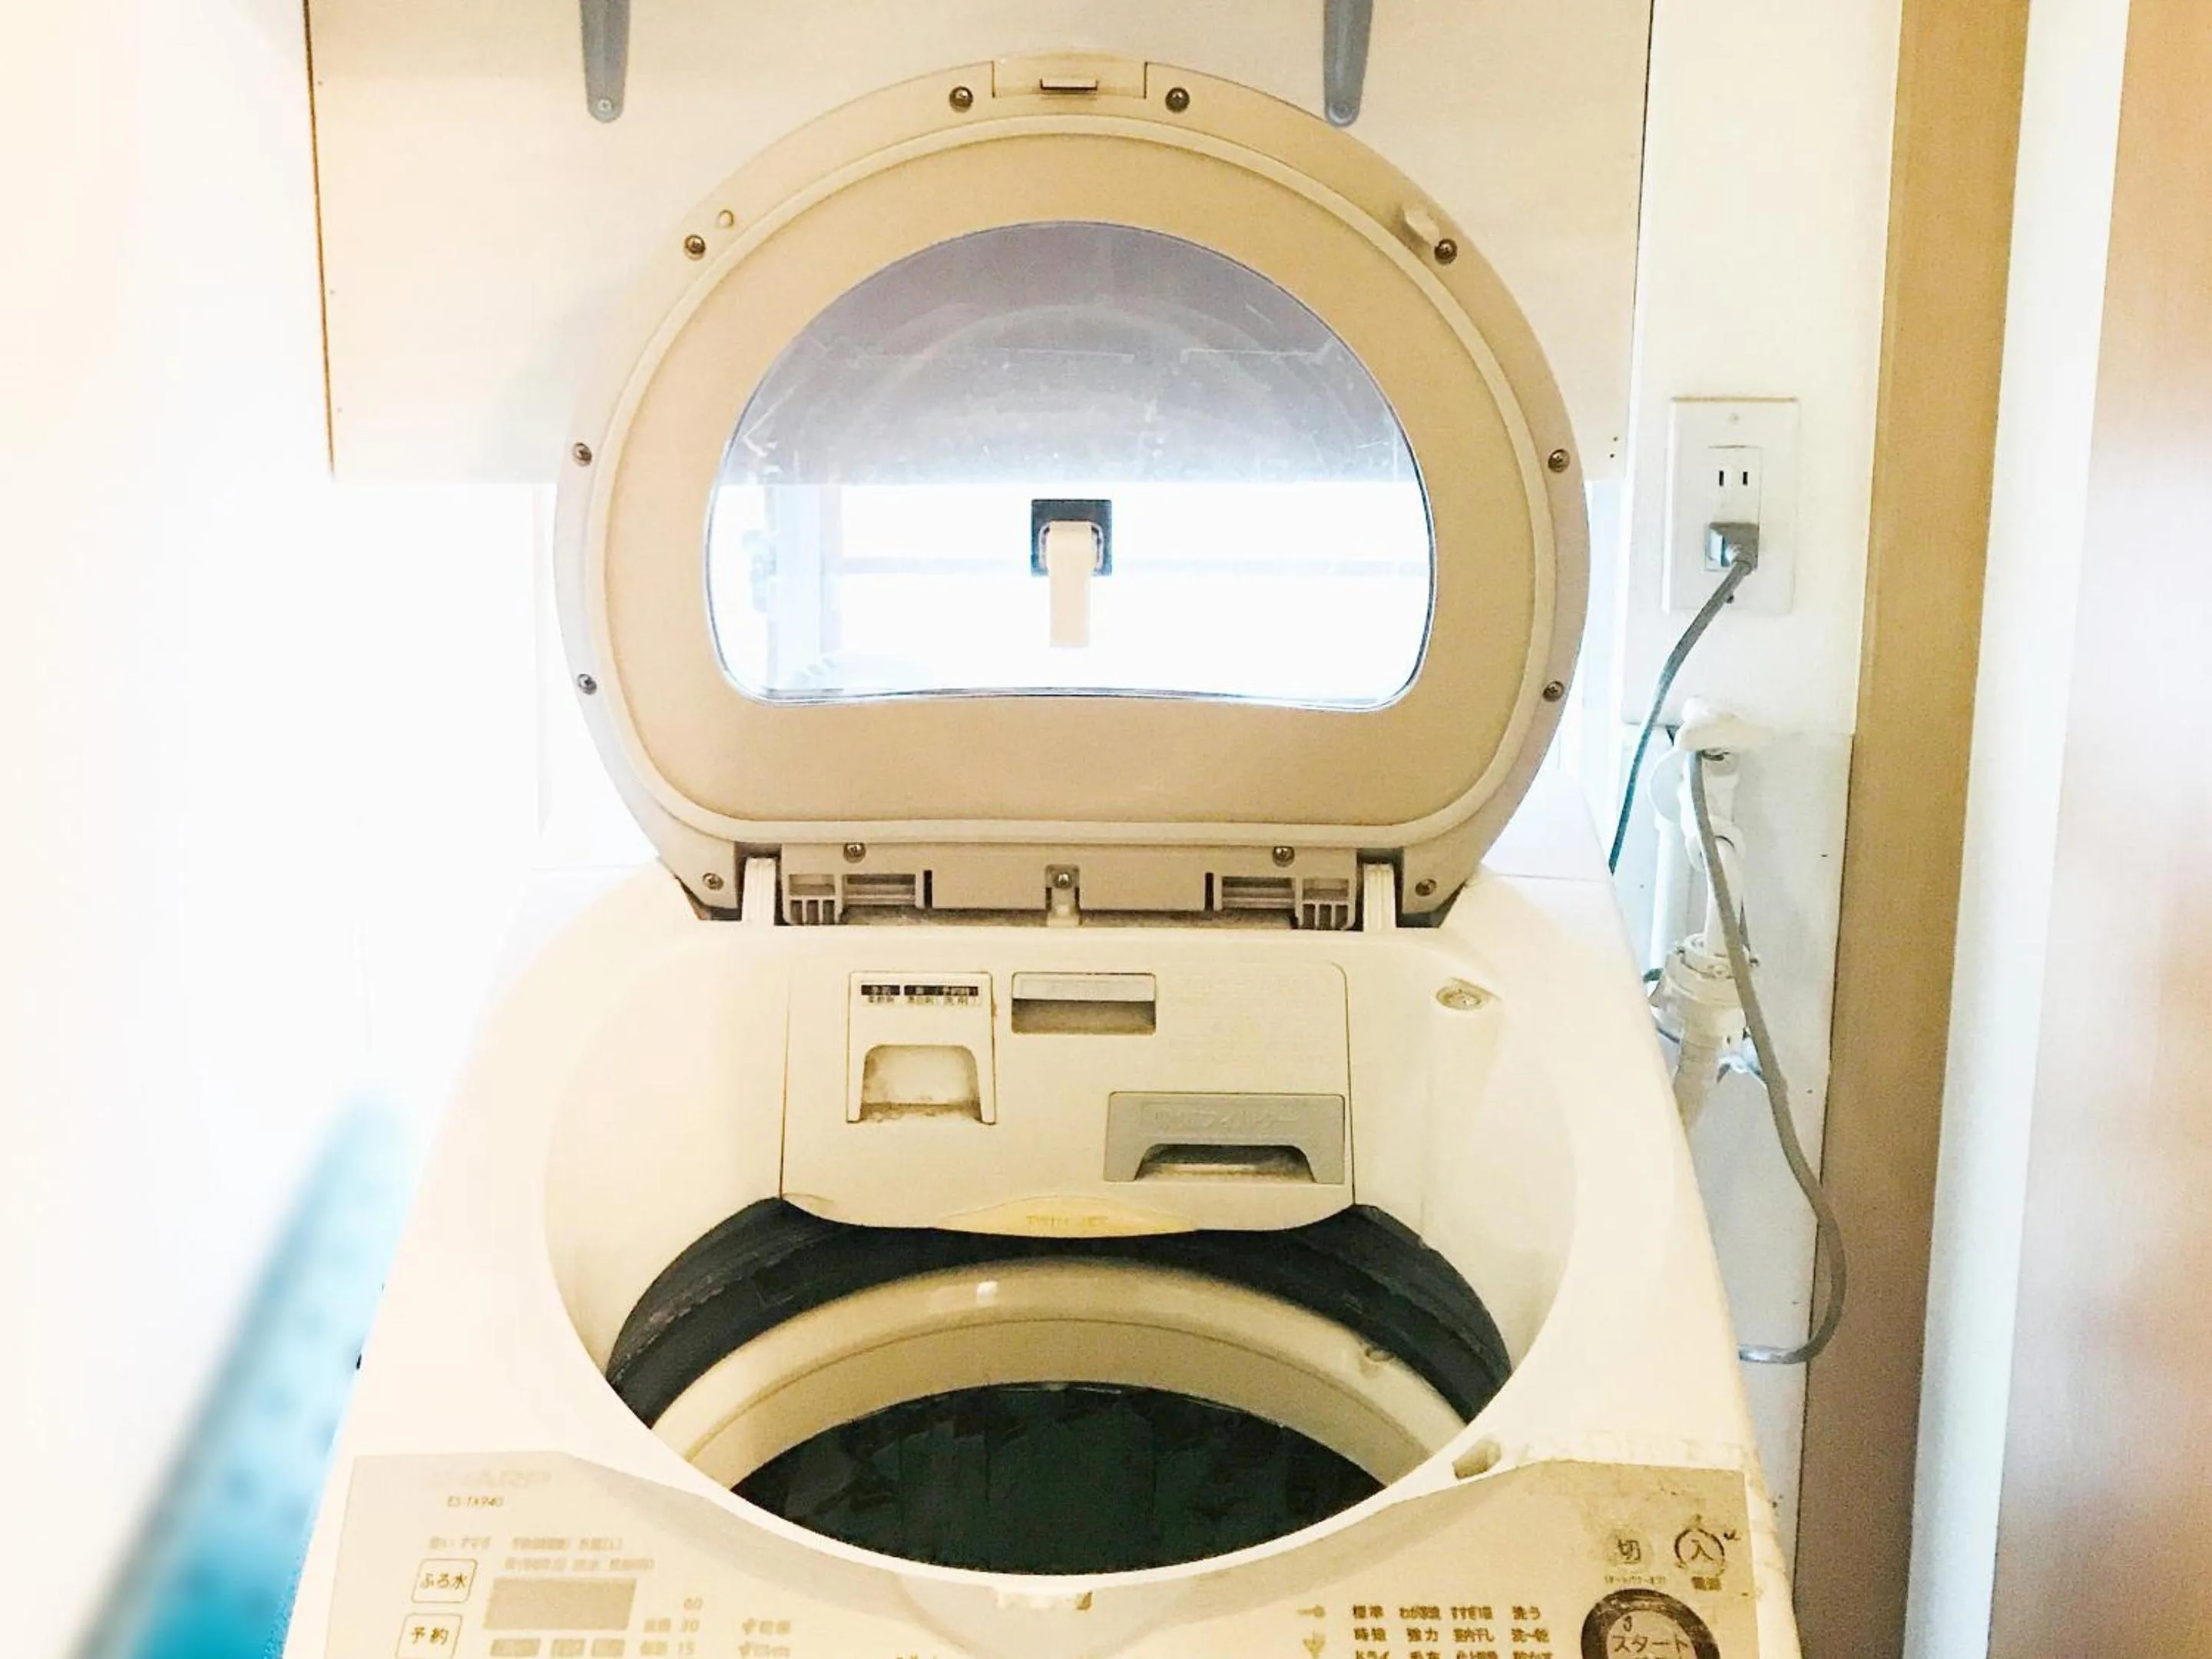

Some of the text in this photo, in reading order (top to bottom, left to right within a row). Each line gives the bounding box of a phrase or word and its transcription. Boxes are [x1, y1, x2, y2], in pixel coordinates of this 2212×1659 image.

[1618, 1538, 1641, 1561] 切
[1690, 1538, 1714, 1561] 入
[419, 1571, 468, 1589] ふろ水
[411, 1626, 449, 1645] 予約
[1611, 1632, 1689, 1654] スタート
